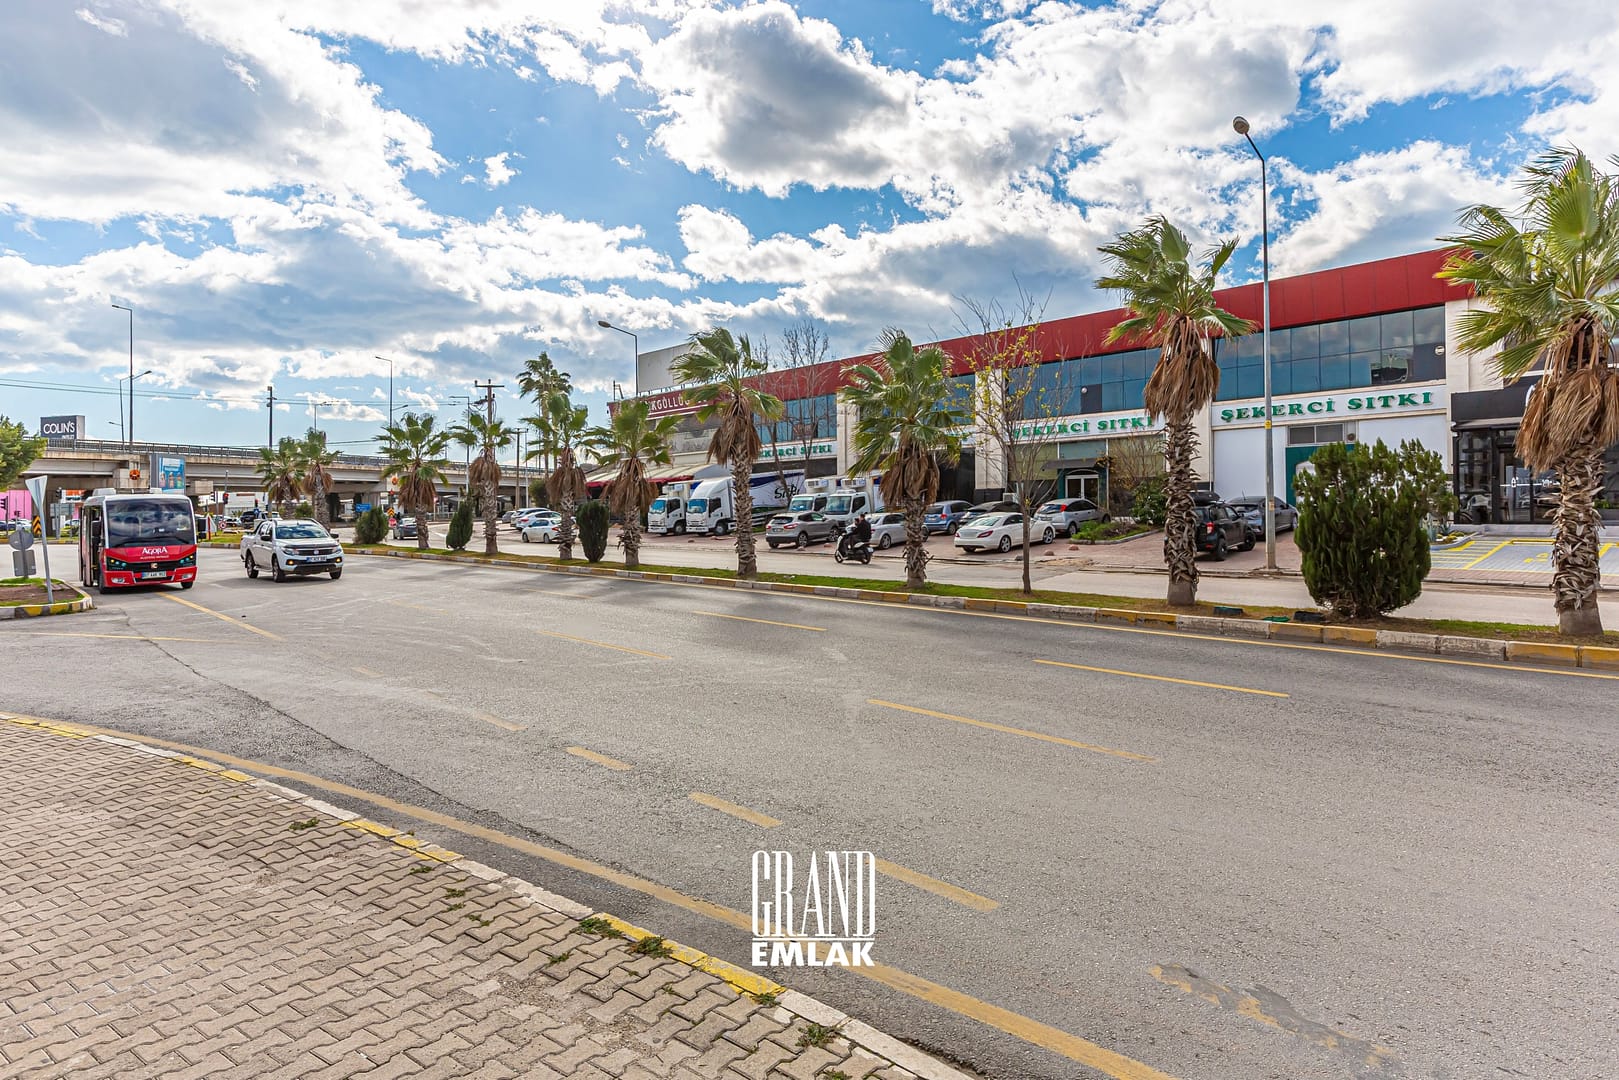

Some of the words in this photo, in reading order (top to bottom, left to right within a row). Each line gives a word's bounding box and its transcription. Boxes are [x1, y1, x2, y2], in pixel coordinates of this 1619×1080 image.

[1220, 397, 1336, 422] ŞEKERCİ
[1347, 391, 1433, 410] SITKI
[43, 421, 75, 434] COLIN'S
[1097, 415, 1153, 430] SITKI
[800, 444, 832, 454] STKI
[142, 546, 168, 555] AGORA
